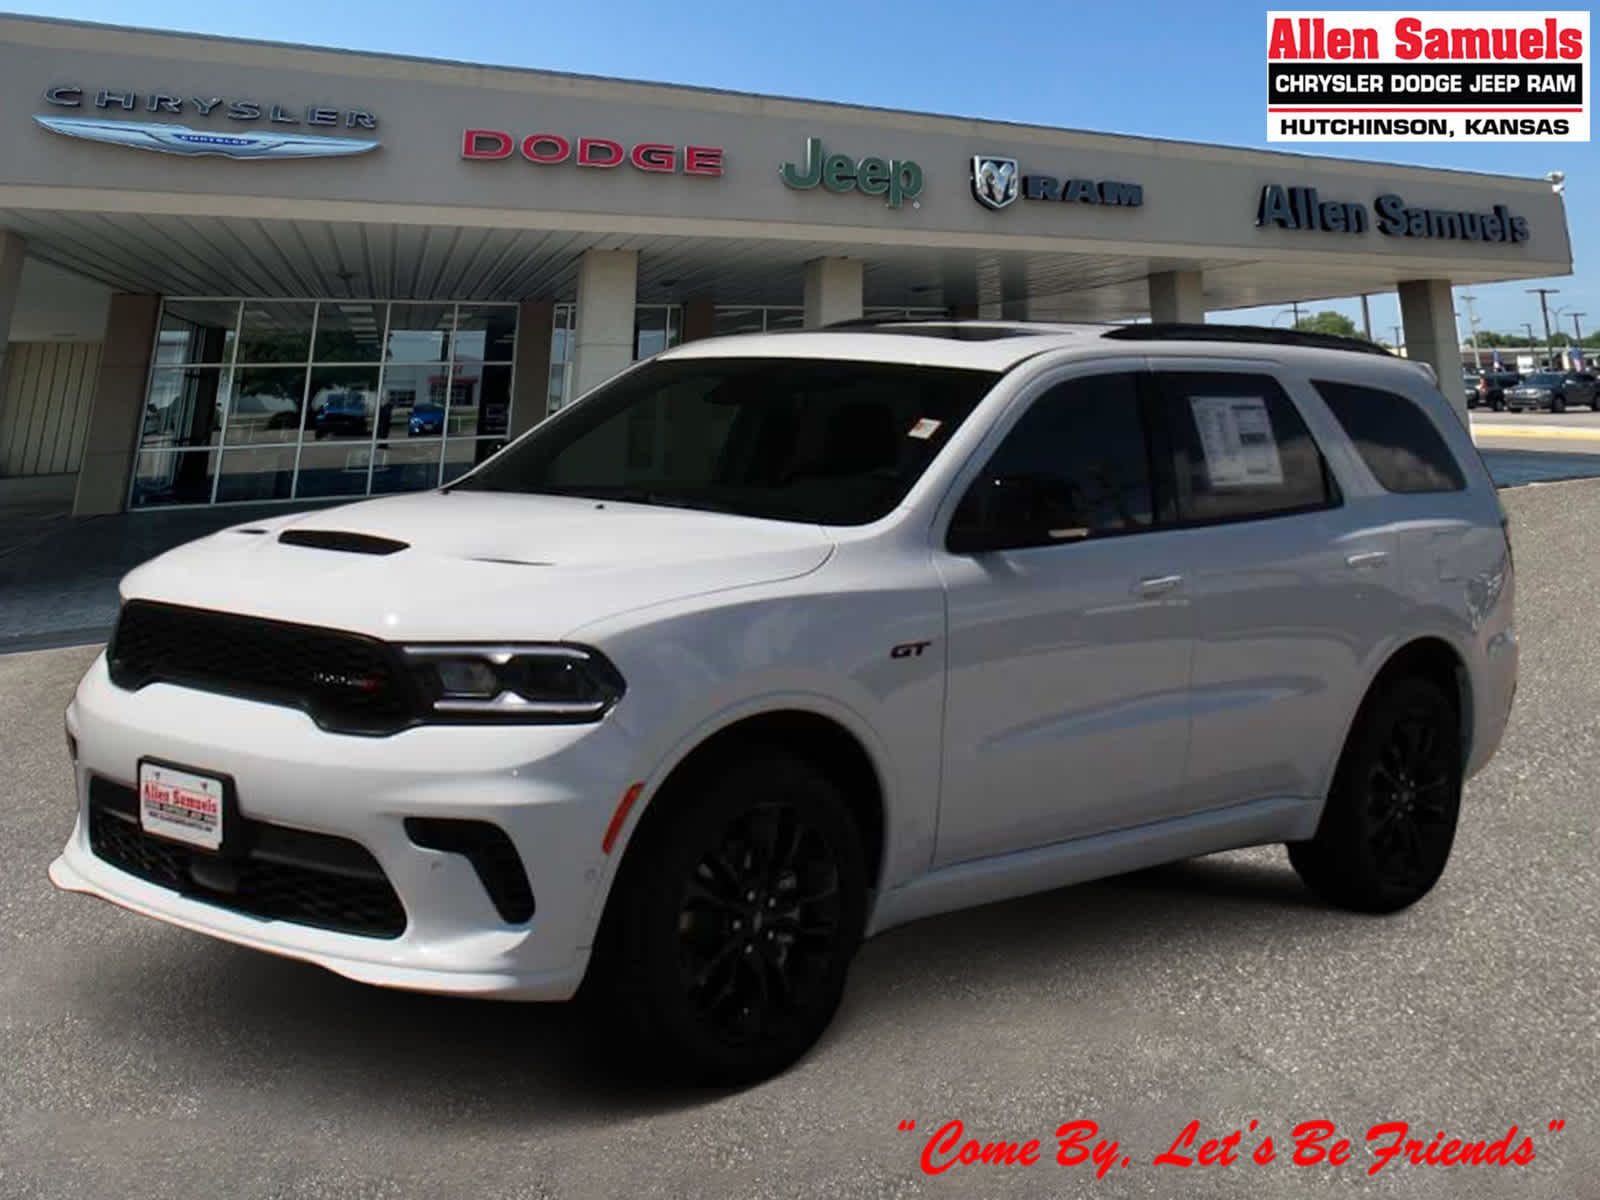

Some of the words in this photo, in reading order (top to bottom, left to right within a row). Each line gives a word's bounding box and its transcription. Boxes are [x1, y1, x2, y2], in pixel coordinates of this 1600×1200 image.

[44, 86, 379, 129] CHRYSLER
[462, 128, 725, 177] DODGE
[780, 137, 923, 208] Jeep
[1023, 174, 1144, 207] RAM
[1256, 183, 1368, 233] Allen
[1375, 193, 1530, 243] Samuels
[889, 640, 932, 659] GT
